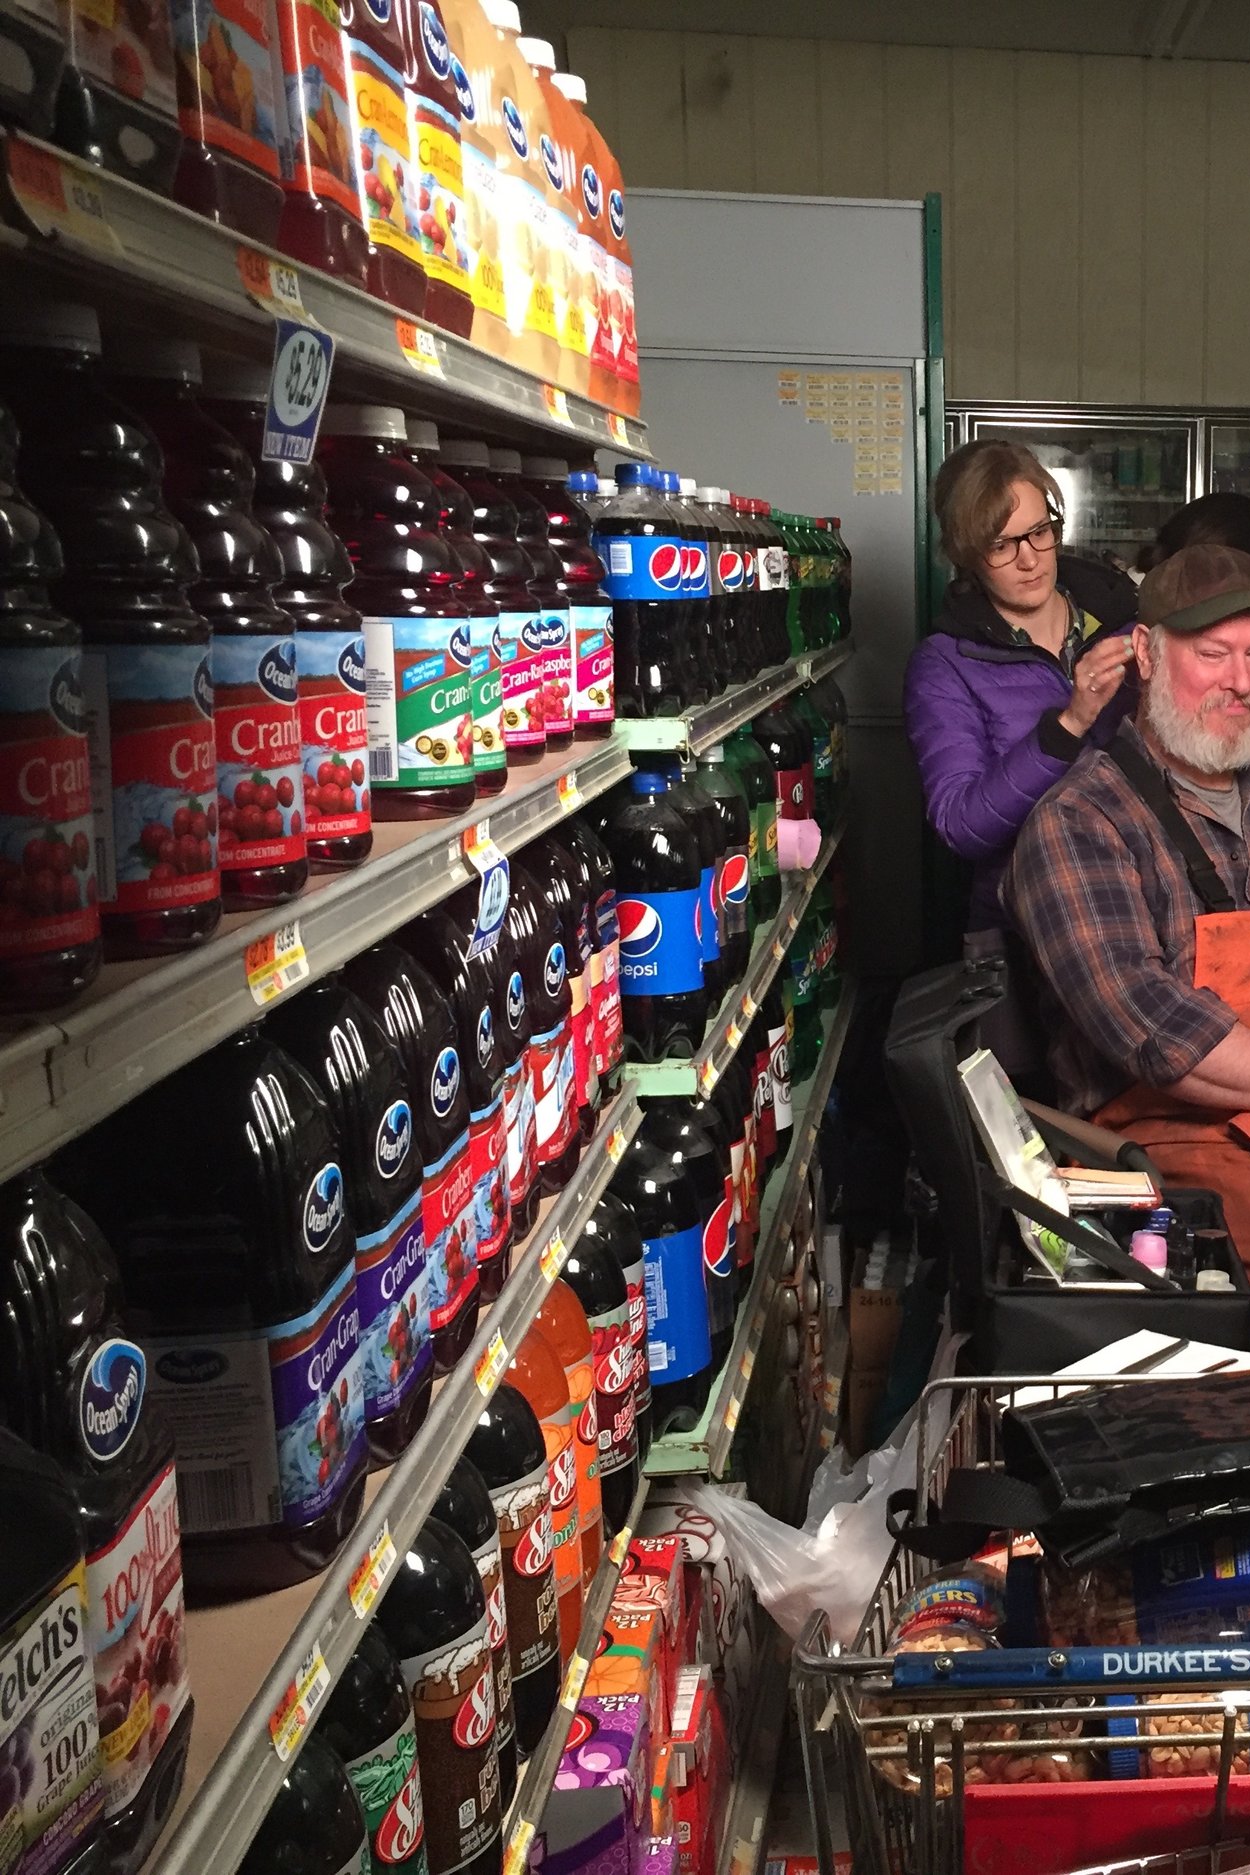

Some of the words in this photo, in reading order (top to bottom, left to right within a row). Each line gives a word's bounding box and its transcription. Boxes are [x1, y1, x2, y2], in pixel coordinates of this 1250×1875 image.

[318, 818, 359, 832] CONCENTRATE
[380, 1229, 427, 1300] Cran-Grap
[307, 1307, 360, 1392] Cran-Grap
[86, 1400, 119, 1436] Ocean
[113, 1364, 139, 1424] Spray
[622, 1619, 640, 1629] 12
[0, 1602, 80, 1722] elch's
[1102, 1647, 1250, 1676] DURKEE'S
[602, 1702, 626, 1713] 12
[36, 1771, 73, 1815] Grape
